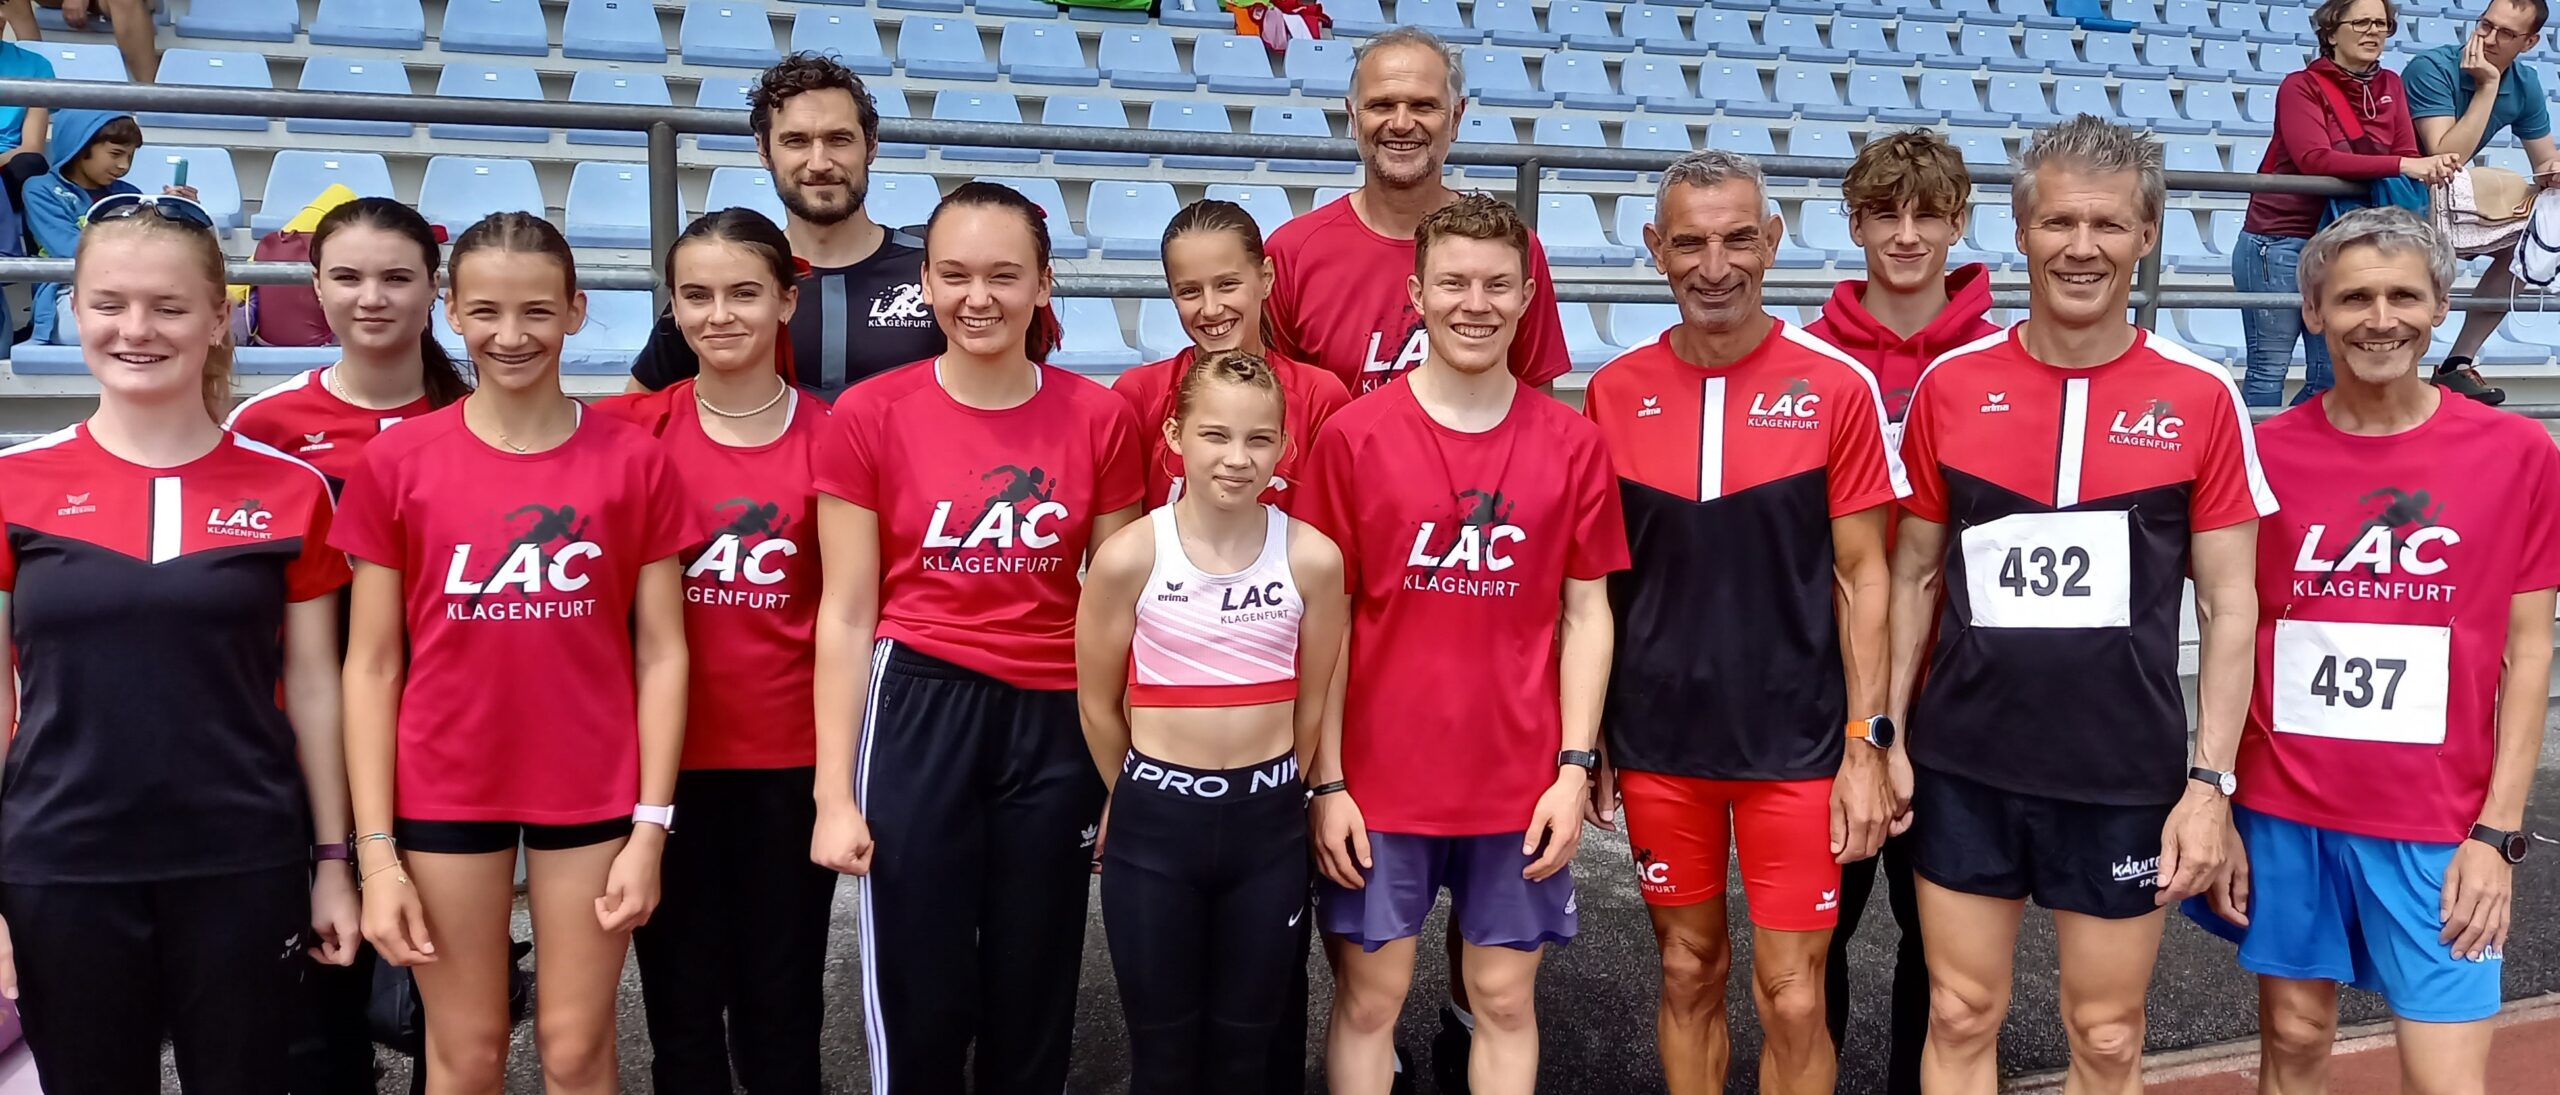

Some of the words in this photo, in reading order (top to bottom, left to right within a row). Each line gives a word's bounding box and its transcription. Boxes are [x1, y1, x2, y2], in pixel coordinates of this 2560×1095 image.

[868, 298, 929, 318] LAC
[1363, 328, 1430, 373] LA
[1749, 392, 1821, 417] LAC
[1980, 403, 2010, 413] erima
[1747, 418, 1820, 430] KLAGENFURT
[2110, 410, 2185, 439] LAC
[2108, 434, 2182, 452] KLAGENFURT
[207, 508, 273, 530] LAC
[921, 500, 1069, 549] LAC
[206, 526, 273, 540] KLAGENFURT
[1406, 521, 1527, 572] LAC
[2293, 524, 2461, 576] LAC
[443, 541, 603, 595] LAC
[685, 533, 798, 585] AC
[922, 556, 1063, 573] KLAGENFURT
[1999, 545, 2092, 597] 432
[1221, 581, 1284, 611] LAC
[1402, 574, 1520, 597] KLAGENFURT
[2292, 579, 2457, 602] KLAGENFURT
[686, 586, 791, 609] GENFURT
[1157, 592, 1189, 603] erima
[446, 599, 596, 621] KLAGENFURT
[1220, 609, 1289, 624] KLAGENFURT
[2310, 655, 2407, 711] 437
[1131, 761, 1229, 798] PRO
[1249, 751, 1299, 794] NIK
[1635, 860, 1669, 884] AC
